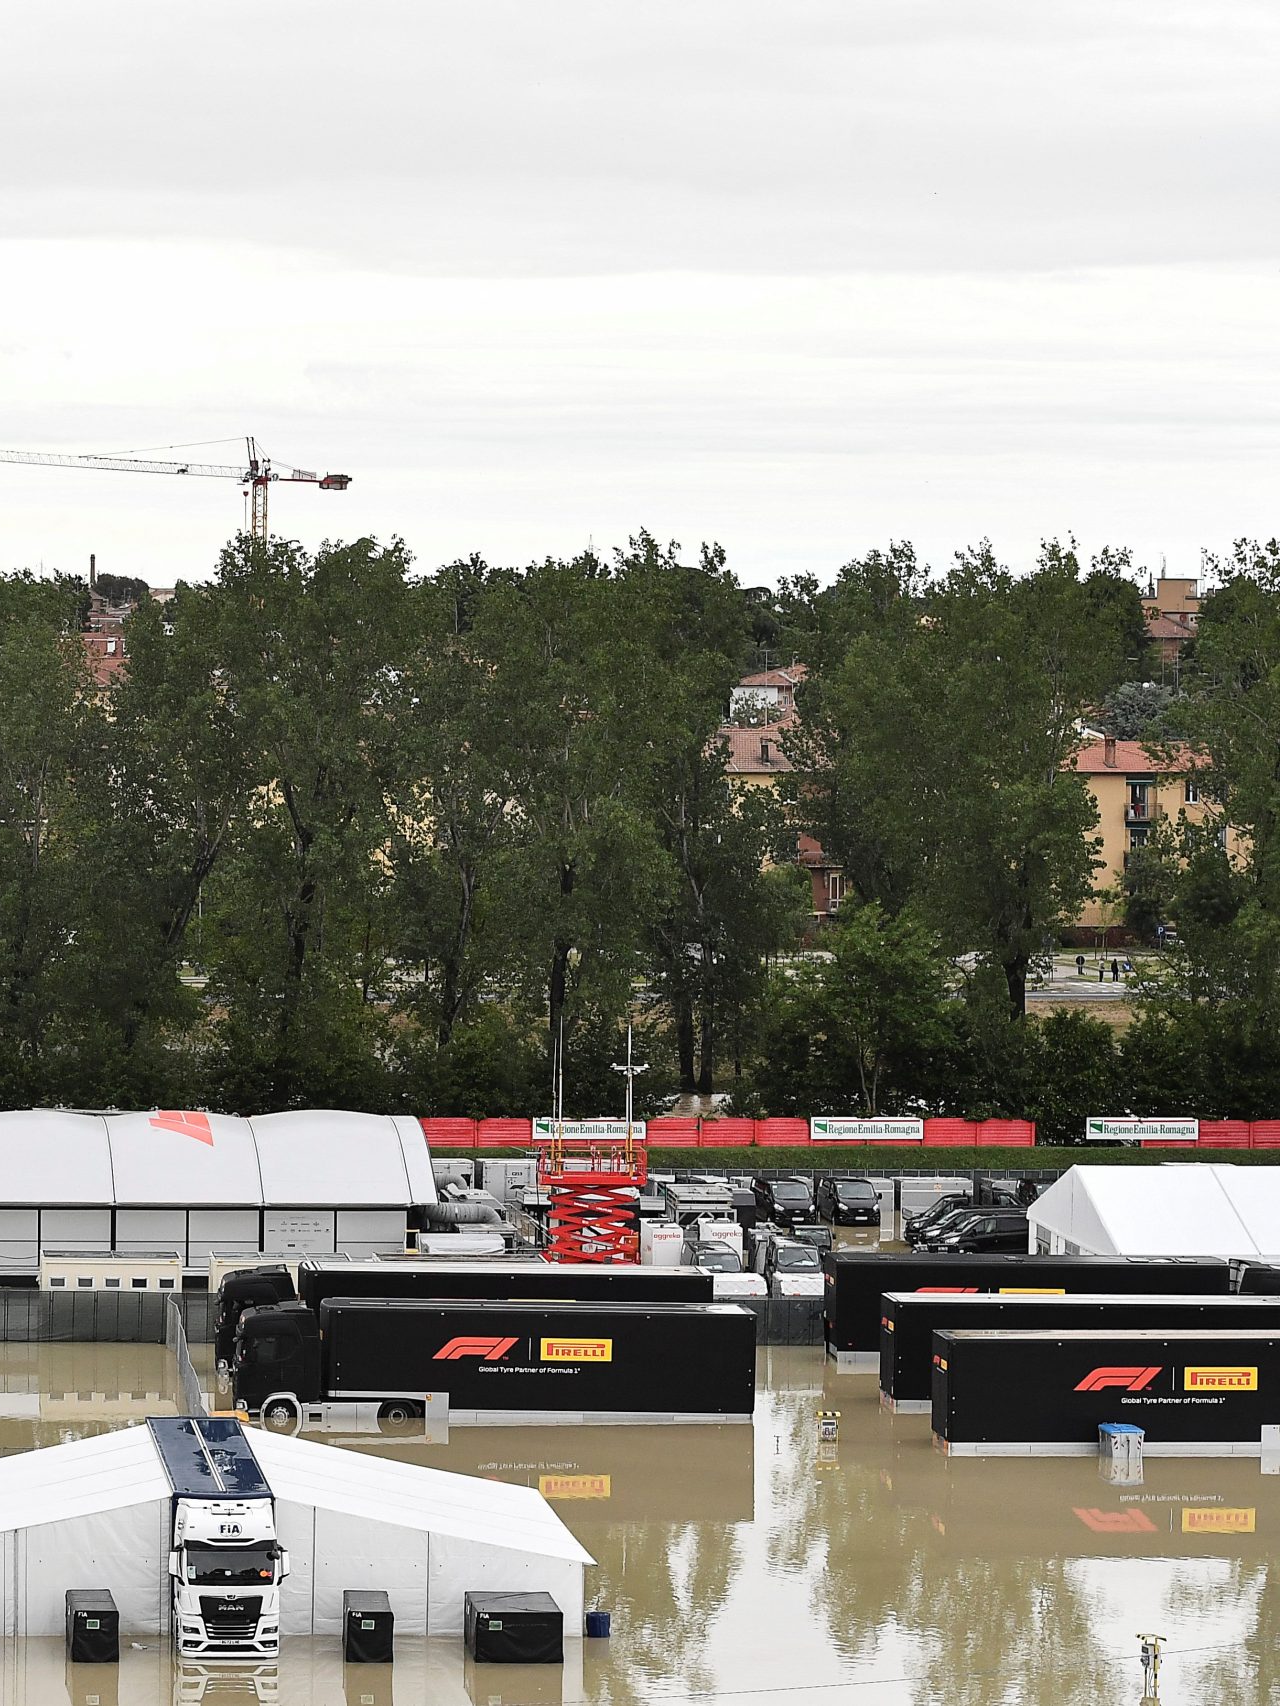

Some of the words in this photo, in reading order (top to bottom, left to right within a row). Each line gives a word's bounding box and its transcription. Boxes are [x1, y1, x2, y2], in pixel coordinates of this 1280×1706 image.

[653, 1232, 680, 1240] aggreko
[712, 1230, 742, 1239] aggreko
[432, 1337, 519, 1360] F1
[547, 1343, 605, 1356] PIRELLI
[1073, 1367, 1163, 1391] F1
[1191, 1372, 1251, 1385] PIRELLI
[1143, 1397, 1157, 1405] Tyre
